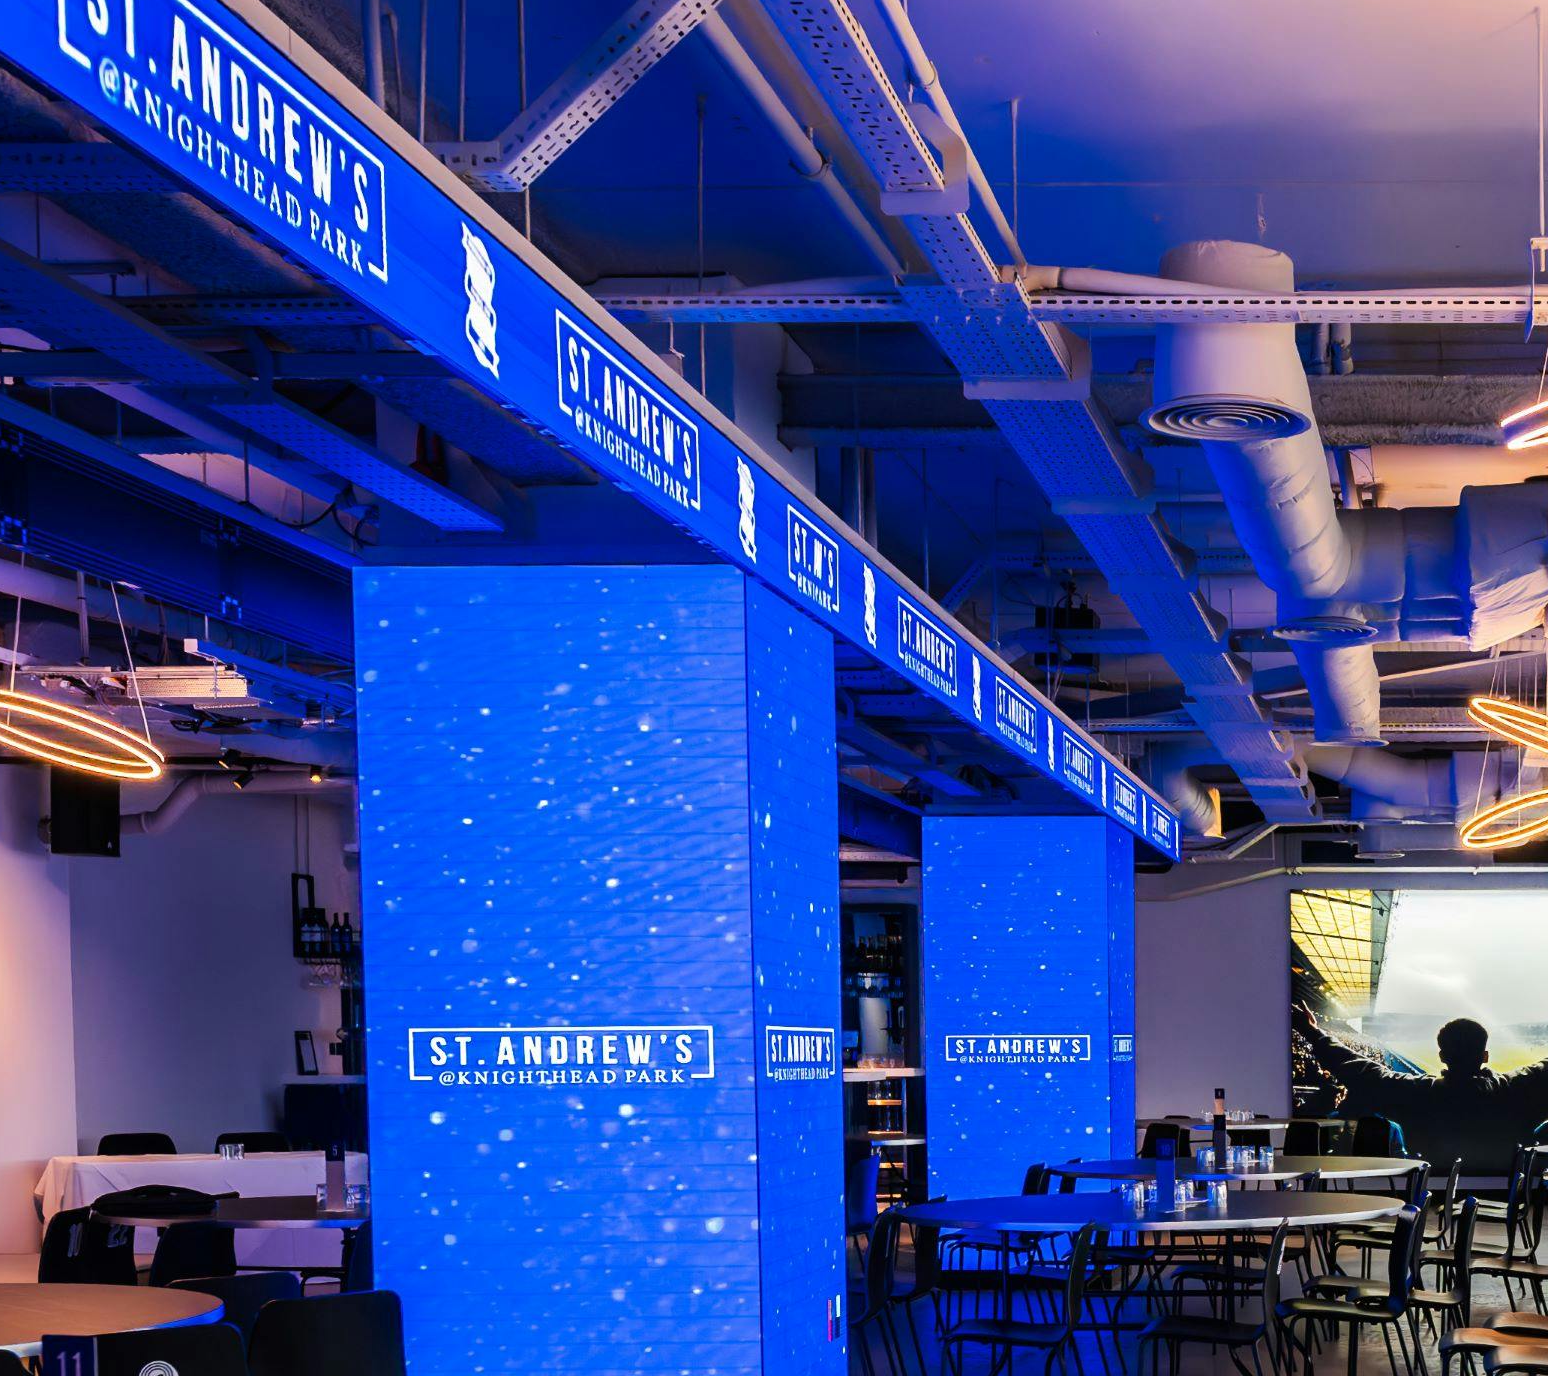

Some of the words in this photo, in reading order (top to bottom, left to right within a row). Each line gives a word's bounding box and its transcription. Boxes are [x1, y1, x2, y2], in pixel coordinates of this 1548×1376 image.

[170, 14, 369, 233] ANDREW'S
[98, 56, 302, 229] @KNIGHTHEAD
[309, 208, 364, 277] PARK
[603, 365, 692, 480] ANDREW'S
[575, 405, 661, 489] @KNIGHTHEAD
[663, 470, 689, 510] PARK
[496, 1034, 693, 1065] ANDREW'S
[787, 1034, 831, 1062] ANDREW'S
[987, 1038, 1081, 1054] ANDREW'S
[1048, 1055, 1077, 1063] PARK
[438, 1069, 618, 1087] @KNIGHTHEAD
[625, 1068, 686, 1084] PARK
